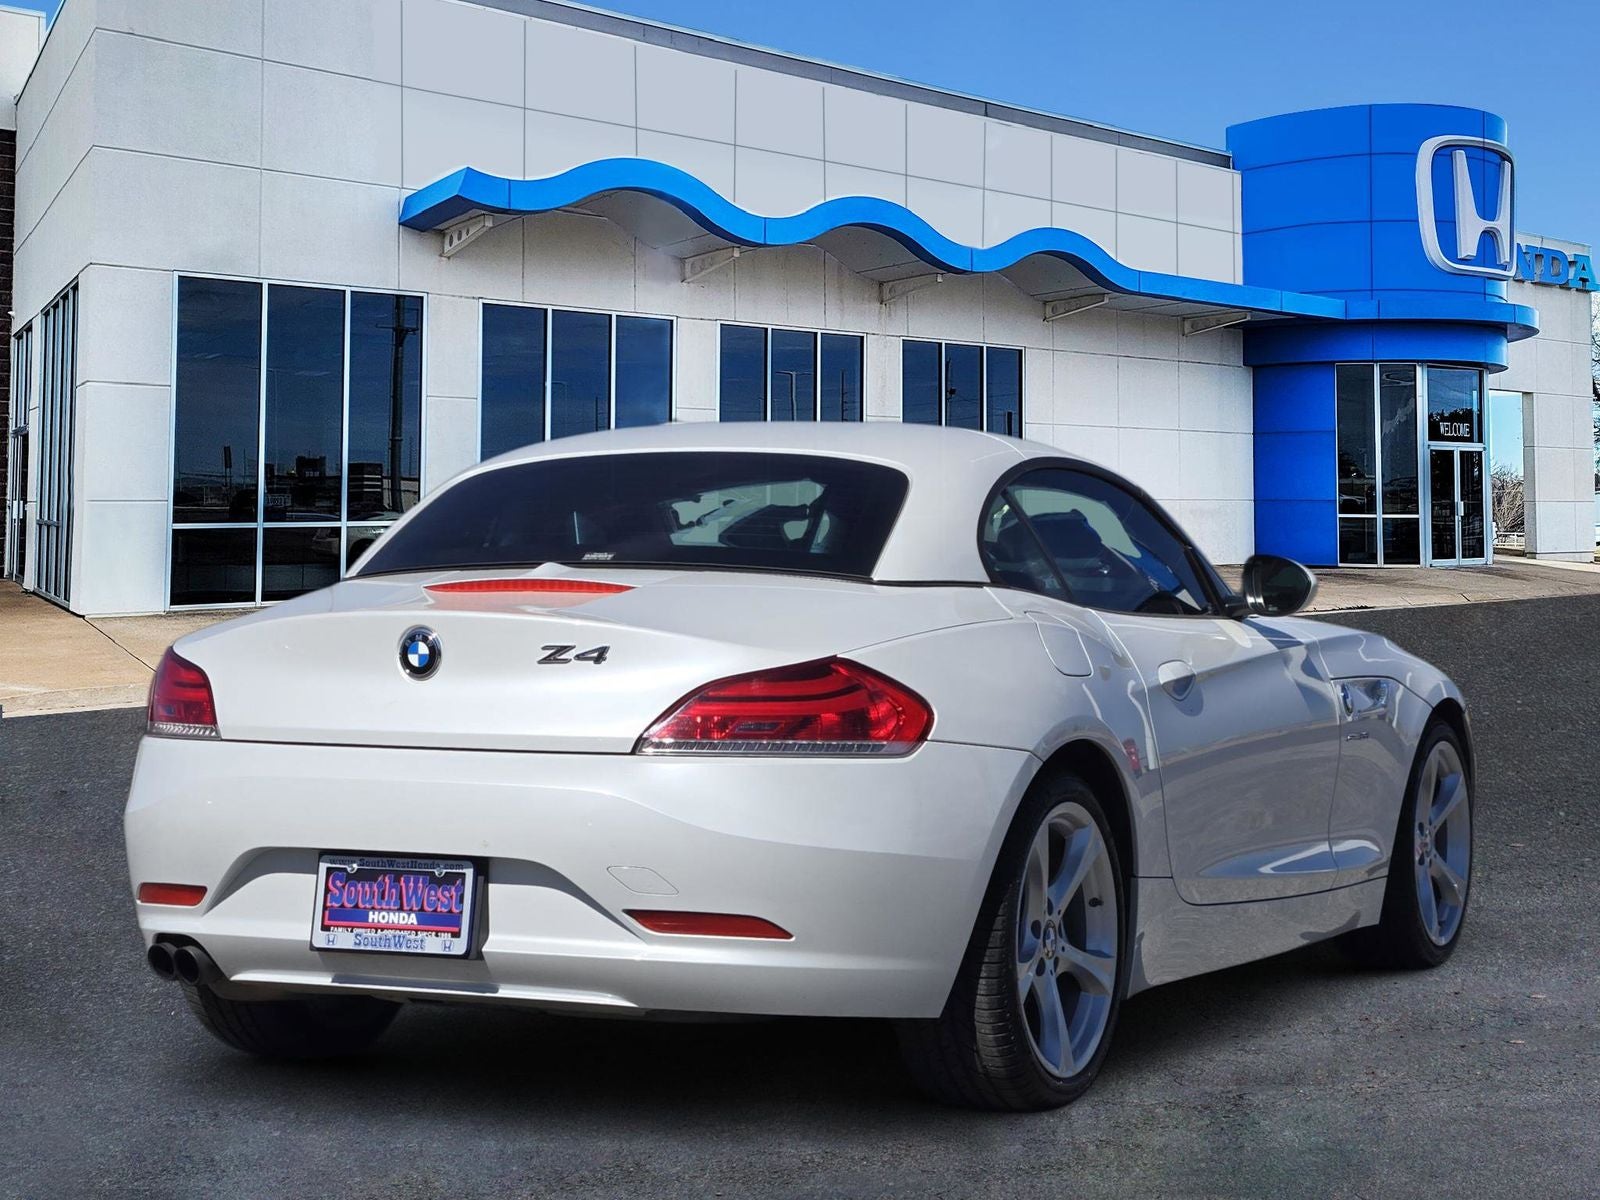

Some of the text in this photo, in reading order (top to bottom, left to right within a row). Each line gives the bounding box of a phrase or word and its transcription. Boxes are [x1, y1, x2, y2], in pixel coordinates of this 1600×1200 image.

[1439, 421, 1470, 437] WELCOME
[536, 644, 611, 665] Z4
[368, 912, 418, 925] HONDA
[354, 933, 426, 950] SouthWest
